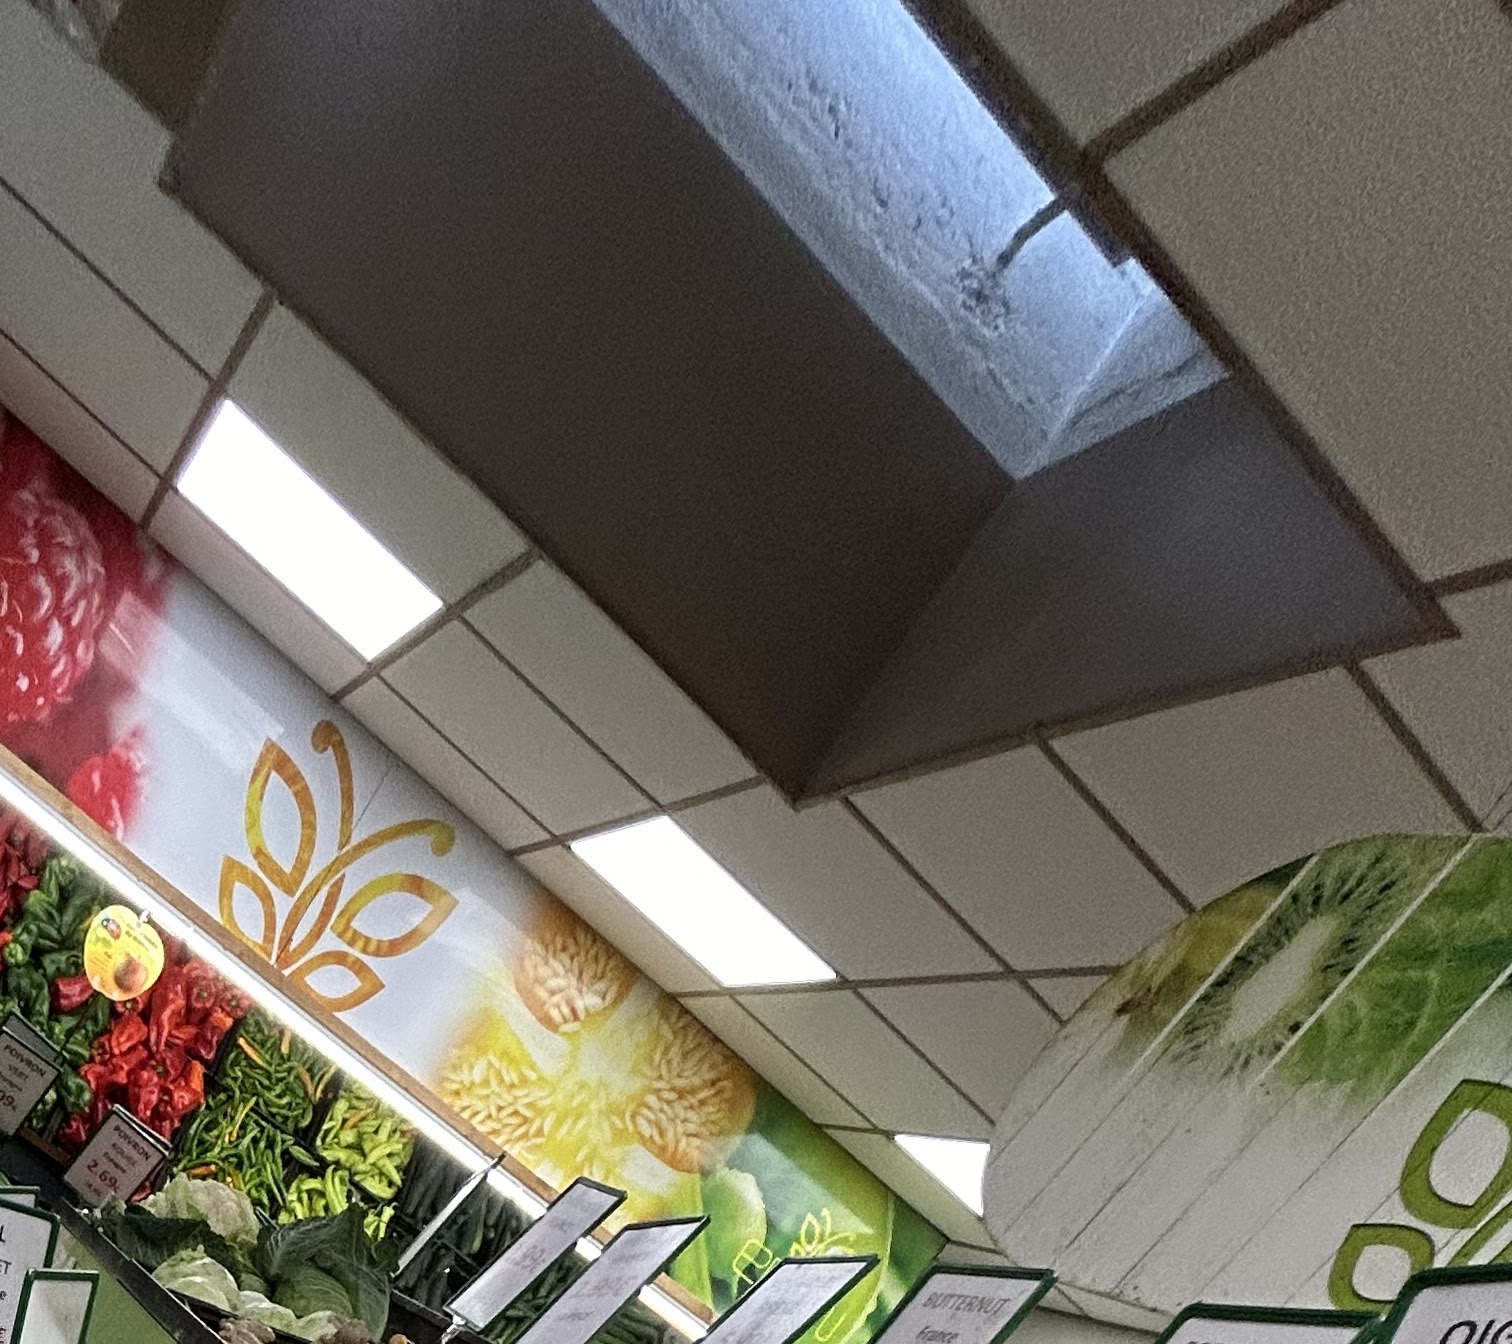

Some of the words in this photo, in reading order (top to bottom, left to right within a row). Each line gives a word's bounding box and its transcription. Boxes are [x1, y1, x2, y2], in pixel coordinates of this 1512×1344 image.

[3, 1044, 47, 1077] POIVRON
[113, 1124, 152, 1161] POIVRON
[922, 1292, 1011, 1315] BUTTERNUT
[915, 1325, 959, 1344] France
